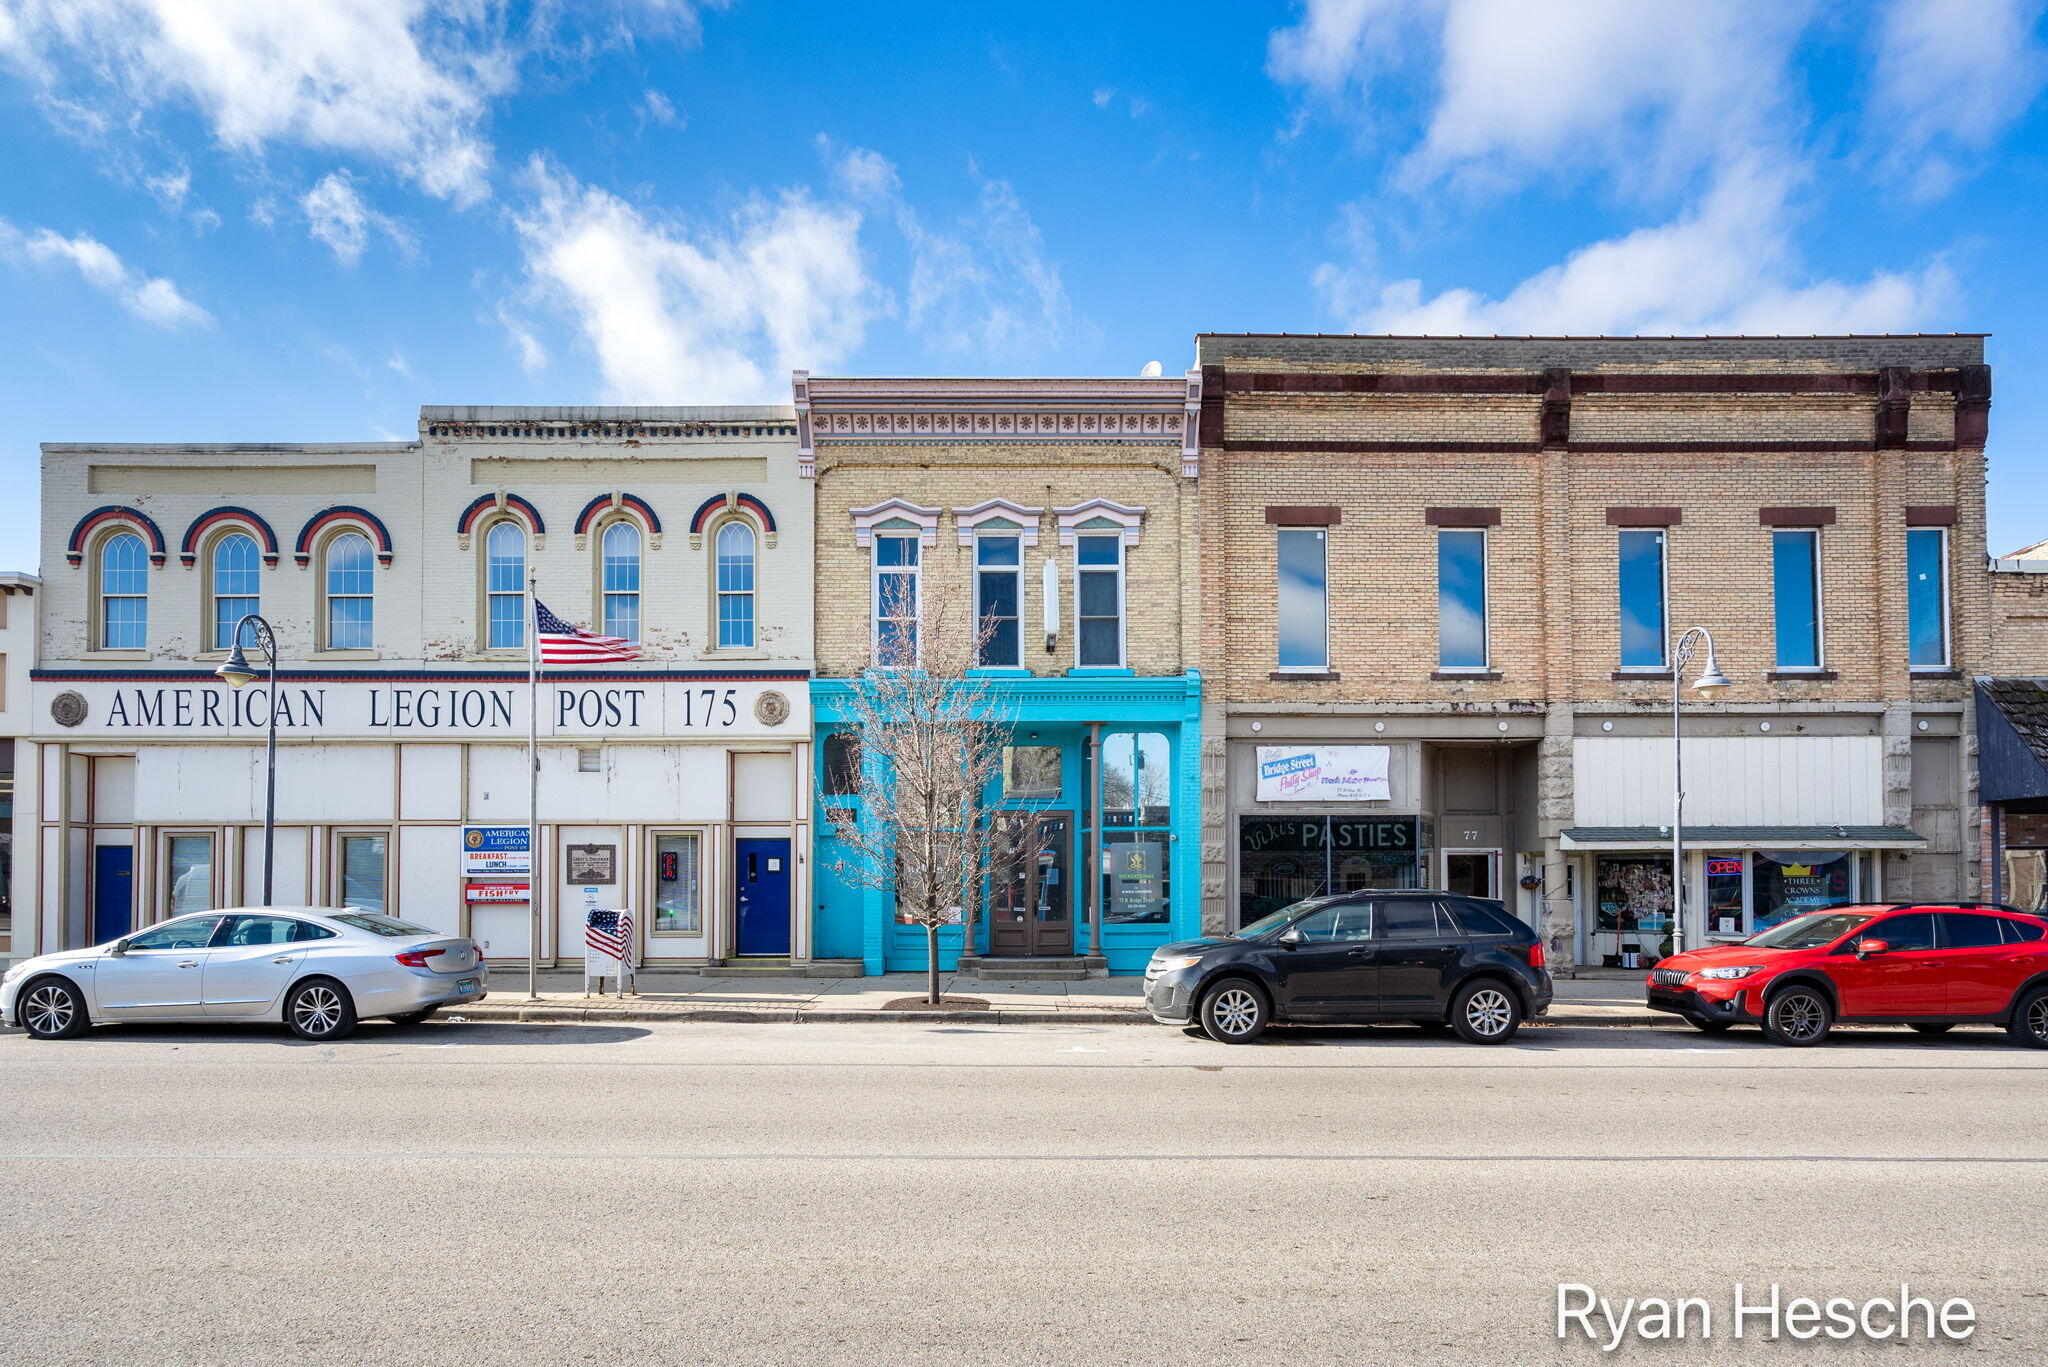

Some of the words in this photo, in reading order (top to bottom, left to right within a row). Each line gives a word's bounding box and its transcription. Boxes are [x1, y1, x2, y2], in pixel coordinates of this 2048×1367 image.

[106, 688, 327, 728] AMERICAN
[368, 688, 515, 728] LEGION
[557, 689, 646, 728] POST
[683, 689, 738, 727] 175
[1263, 762, 1290, 777] Bridge
[1290, 757, 1314, 771] Street
[1280, 773, 1300, 791] Pasty
[1301, 767, 1322, 782] Shop
[1302, 823, 1407, 847] PASTIES
[1463, 831, 1478, 840] 77
[1708, 861, 1743, 874] OPEN
[1788, 877, 1816, 885] THREE
[1784, 896, 1820, 905] ACADEMY
